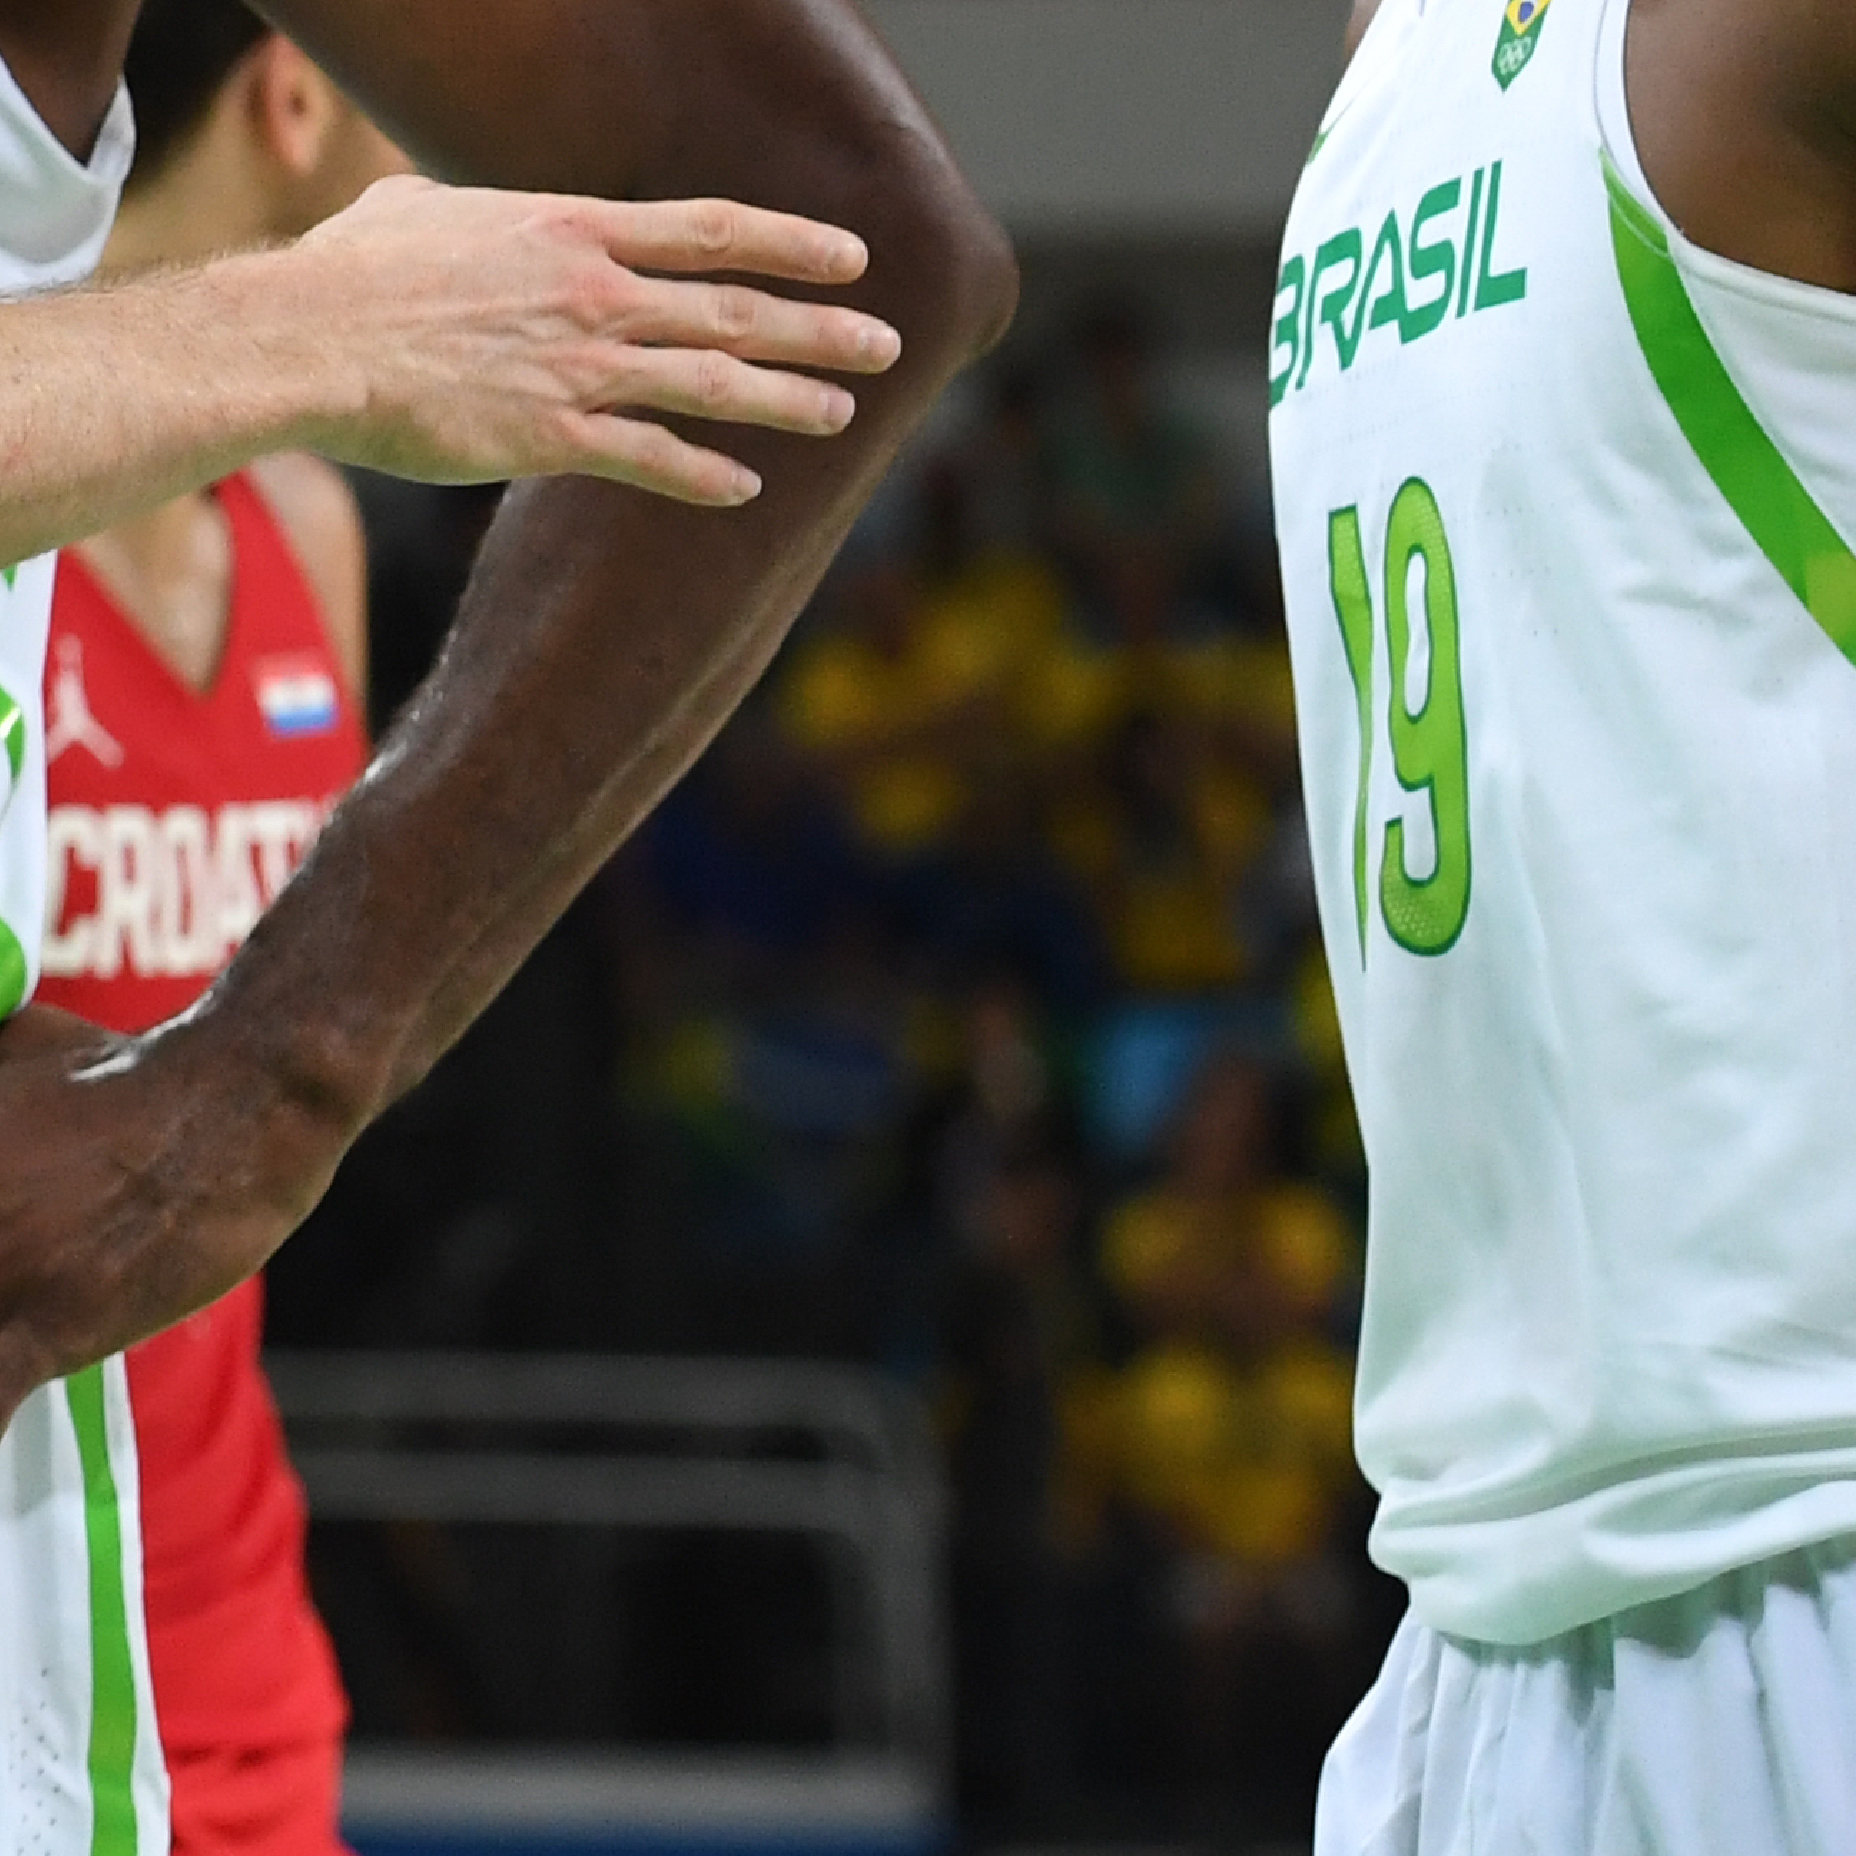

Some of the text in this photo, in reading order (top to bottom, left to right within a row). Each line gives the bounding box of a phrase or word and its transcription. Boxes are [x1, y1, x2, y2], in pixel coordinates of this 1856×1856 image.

[1268, 158, 1527, 410] BRASIL
[1328, 475, 1472, 972] 19
[39, 798, 328, 976] CROAT
